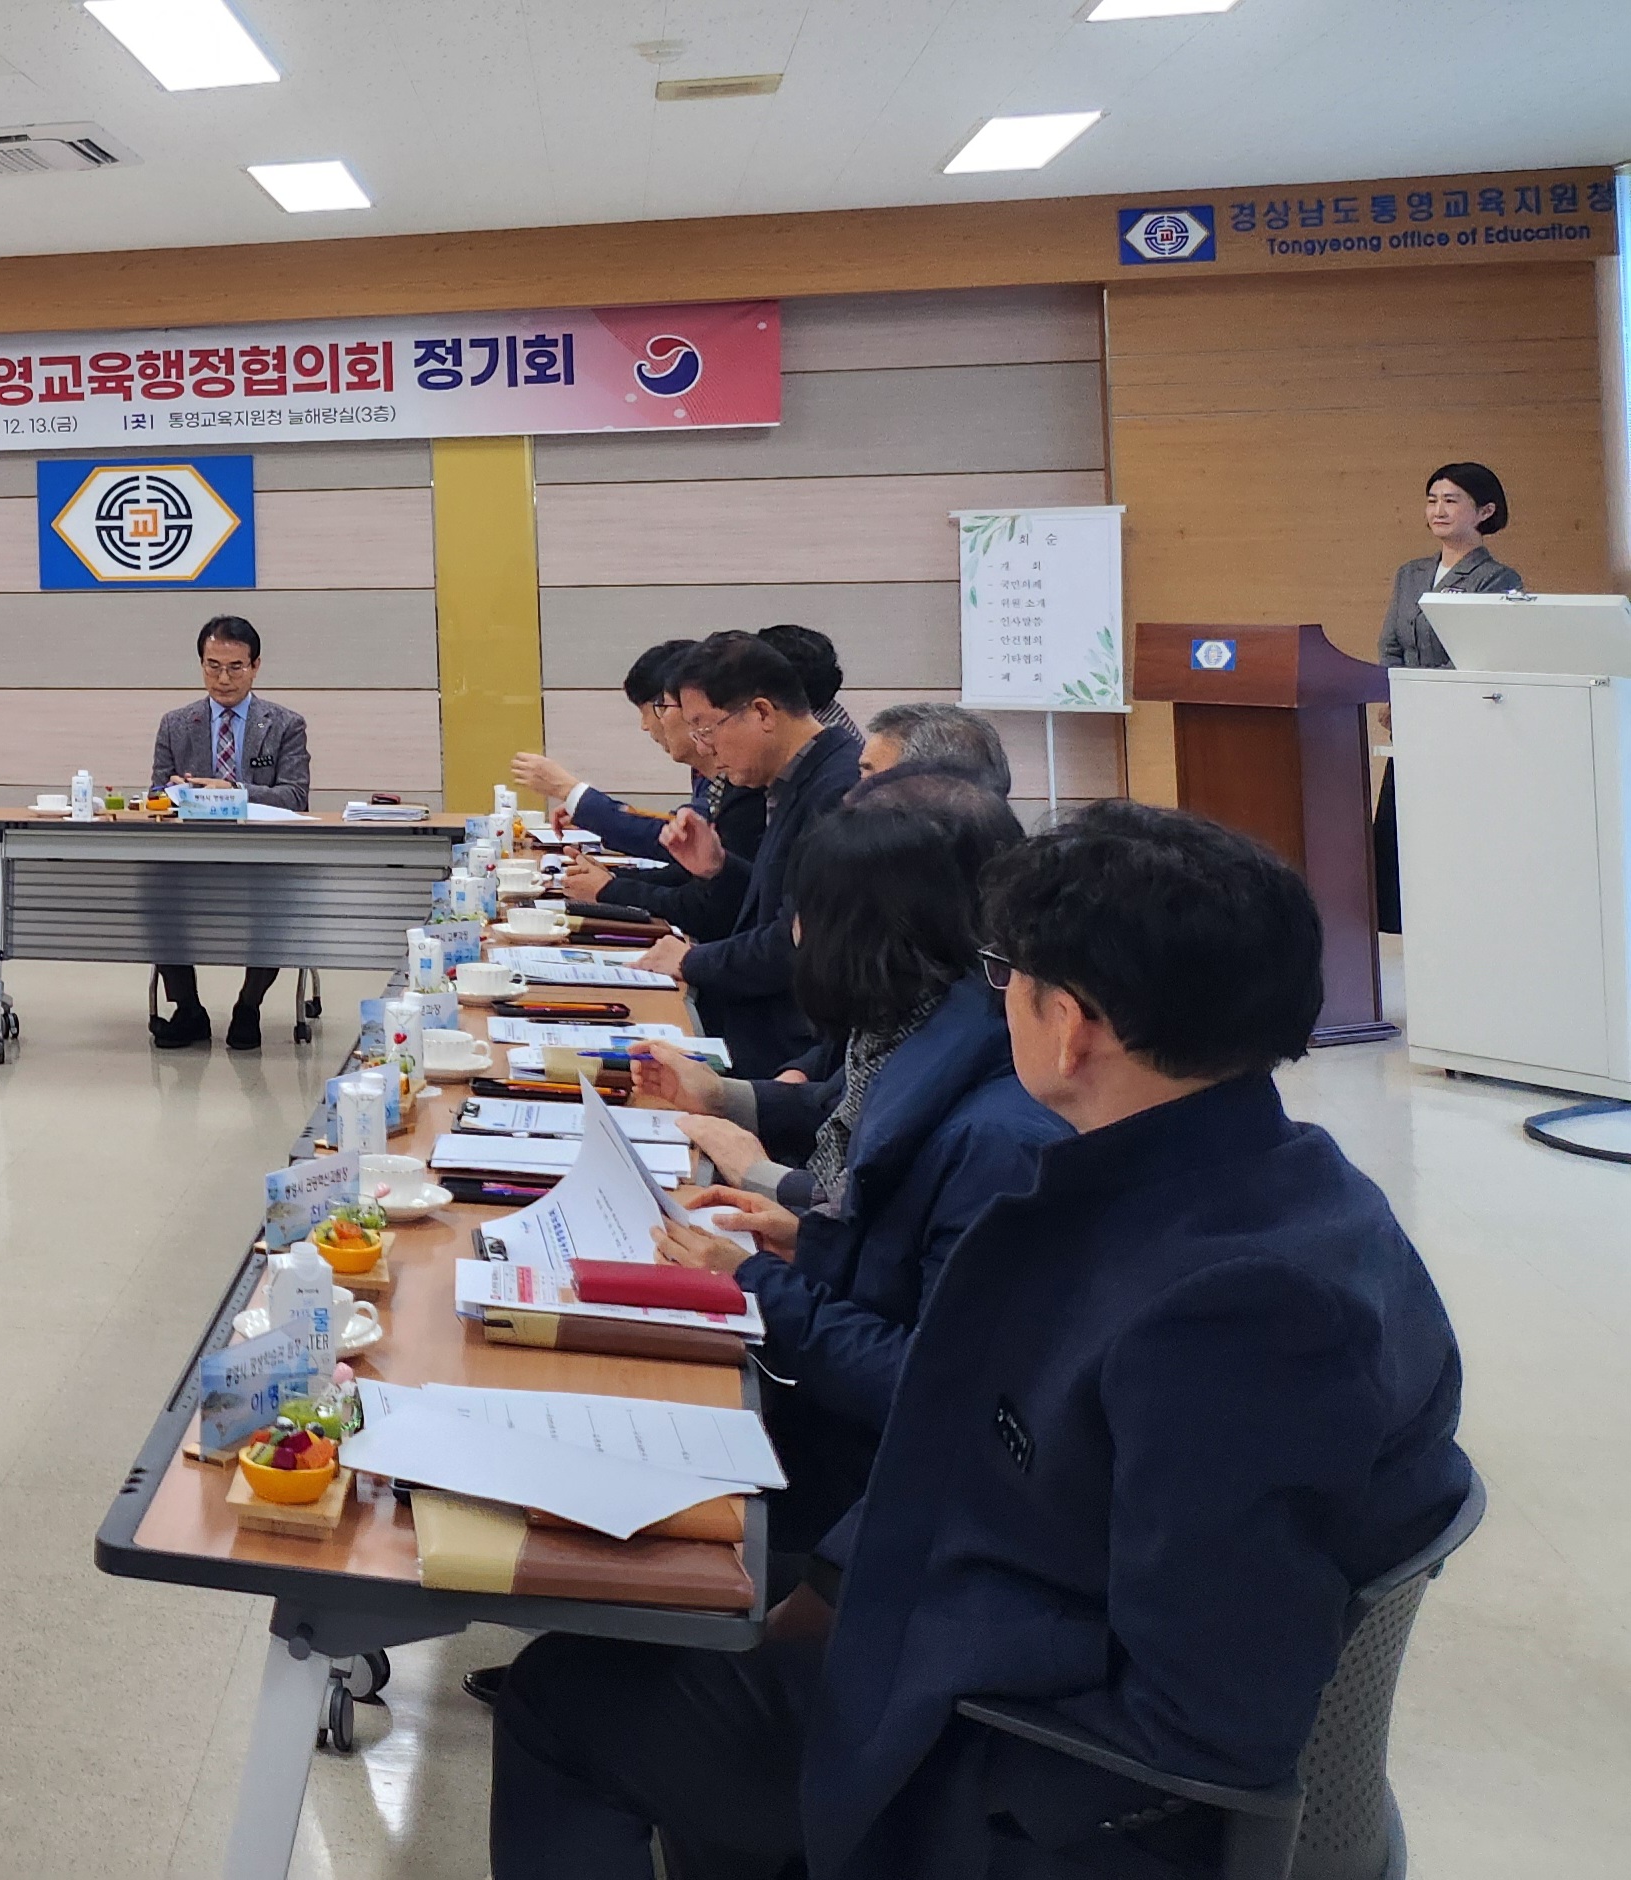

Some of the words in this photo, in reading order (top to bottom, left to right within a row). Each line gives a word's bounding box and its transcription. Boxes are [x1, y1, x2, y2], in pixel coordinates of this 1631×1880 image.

[1266, 235, 1382, 256] Tongyeong
[1388, 230, 1450, 249] office
[1457, 228, 1478, 246] of
[1484, 223, 1591, 244] Education
[412, 333, 575, 391] 정기회
[168, 409, 282, 428] 통영교육지원청
[288, 405, 397, 424] 늘해랑실(3층)
